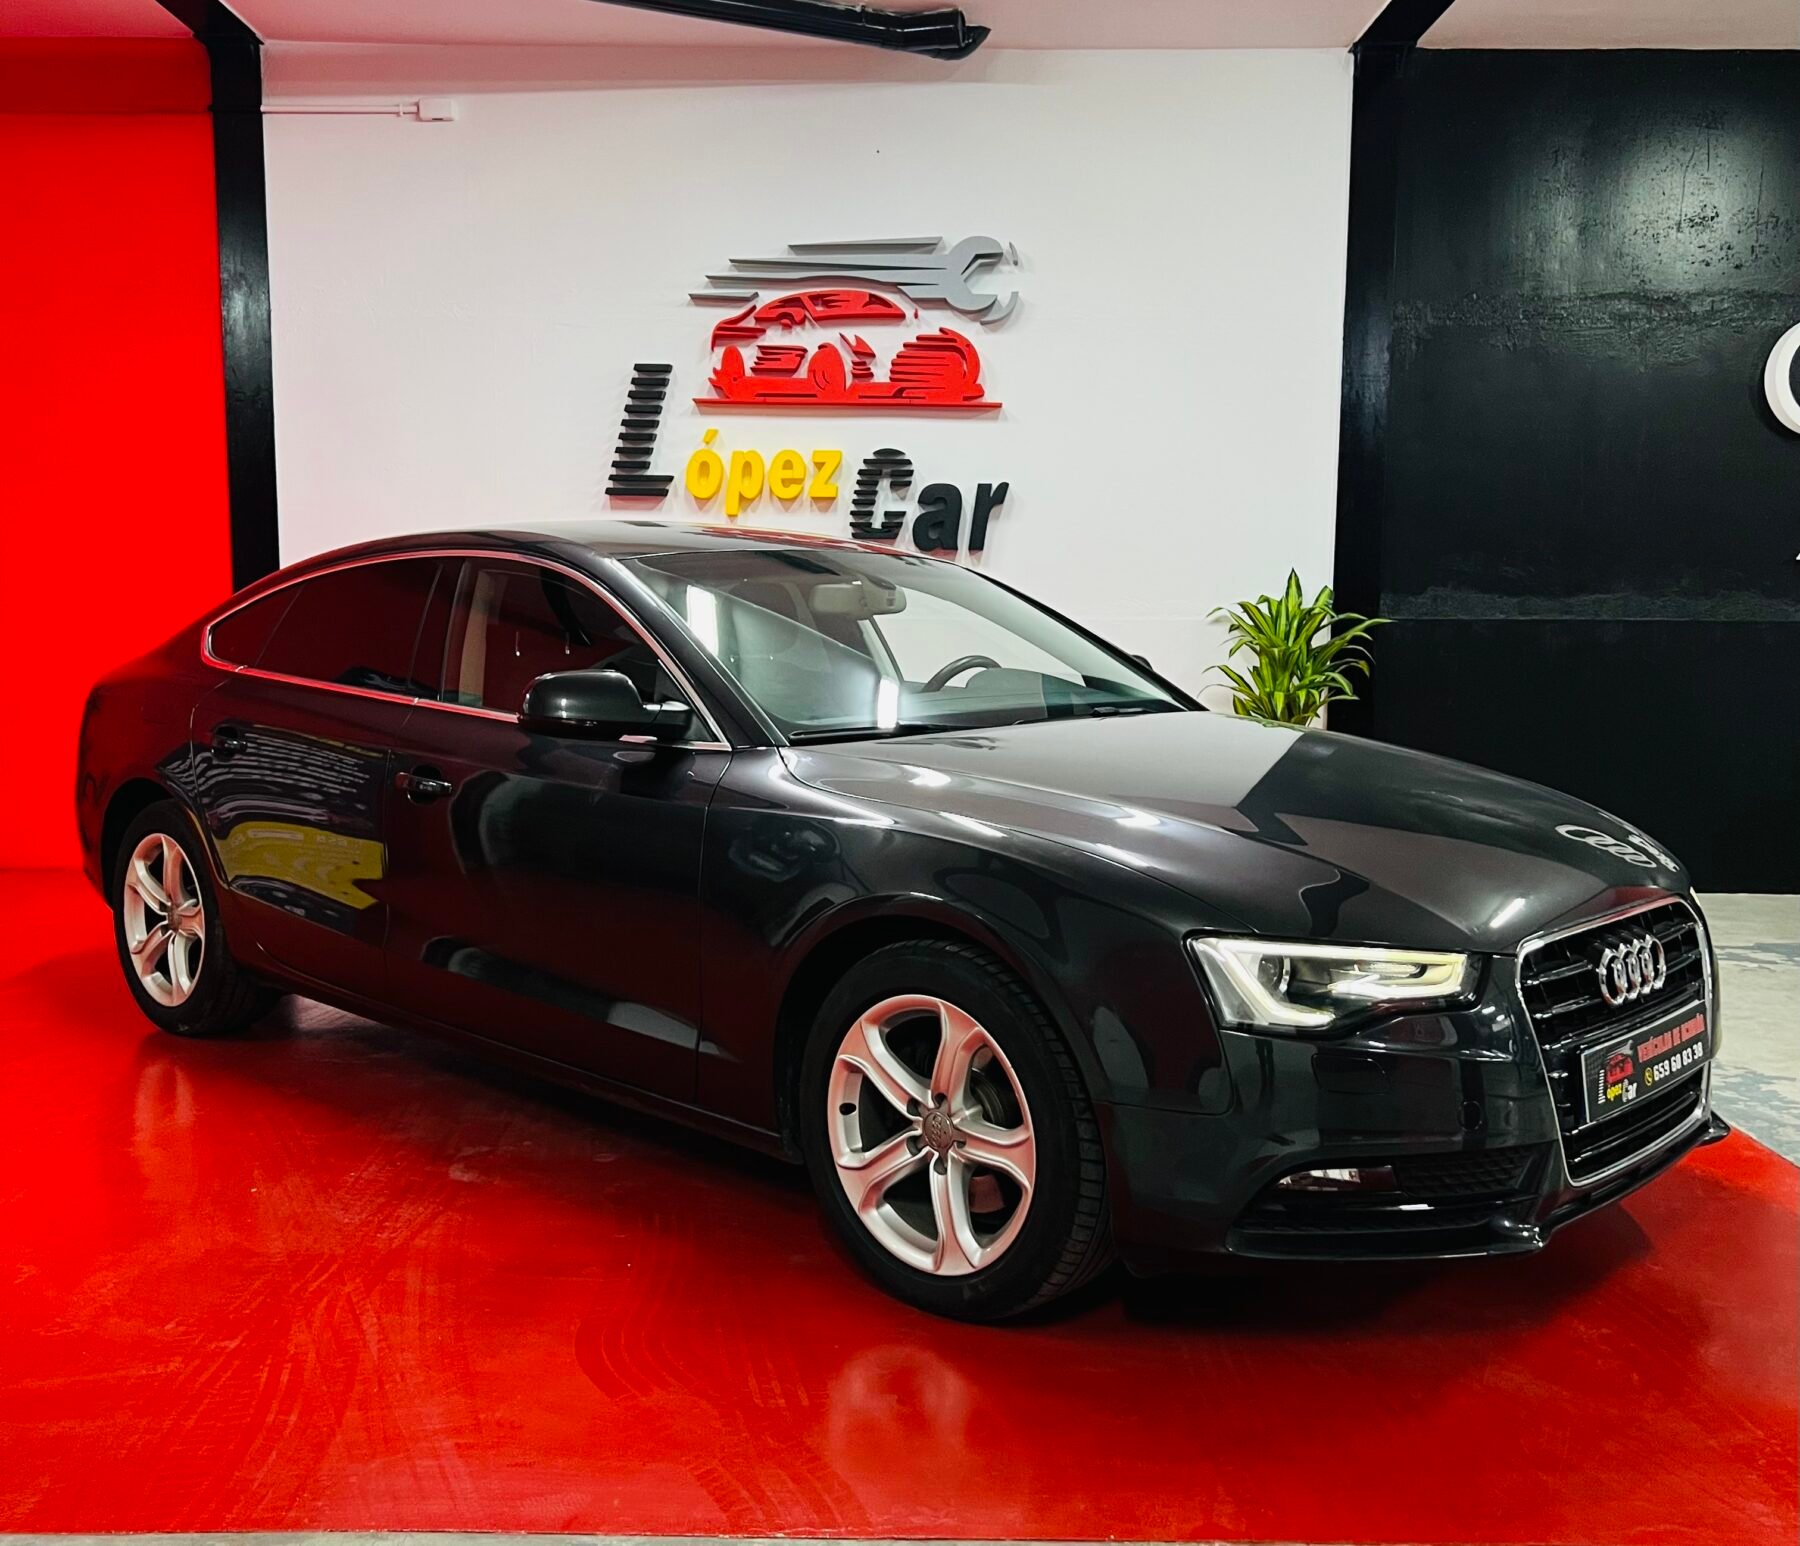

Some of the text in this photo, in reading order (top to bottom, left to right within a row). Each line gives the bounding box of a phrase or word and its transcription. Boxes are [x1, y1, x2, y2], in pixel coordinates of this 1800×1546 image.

[605, 363, 1009, 551] López Car
[1653, 1059, 1670, 1081] 659
[1682, 1047, 1693, 1066] 83
[1622, 1079, 1638, 1103] Car
